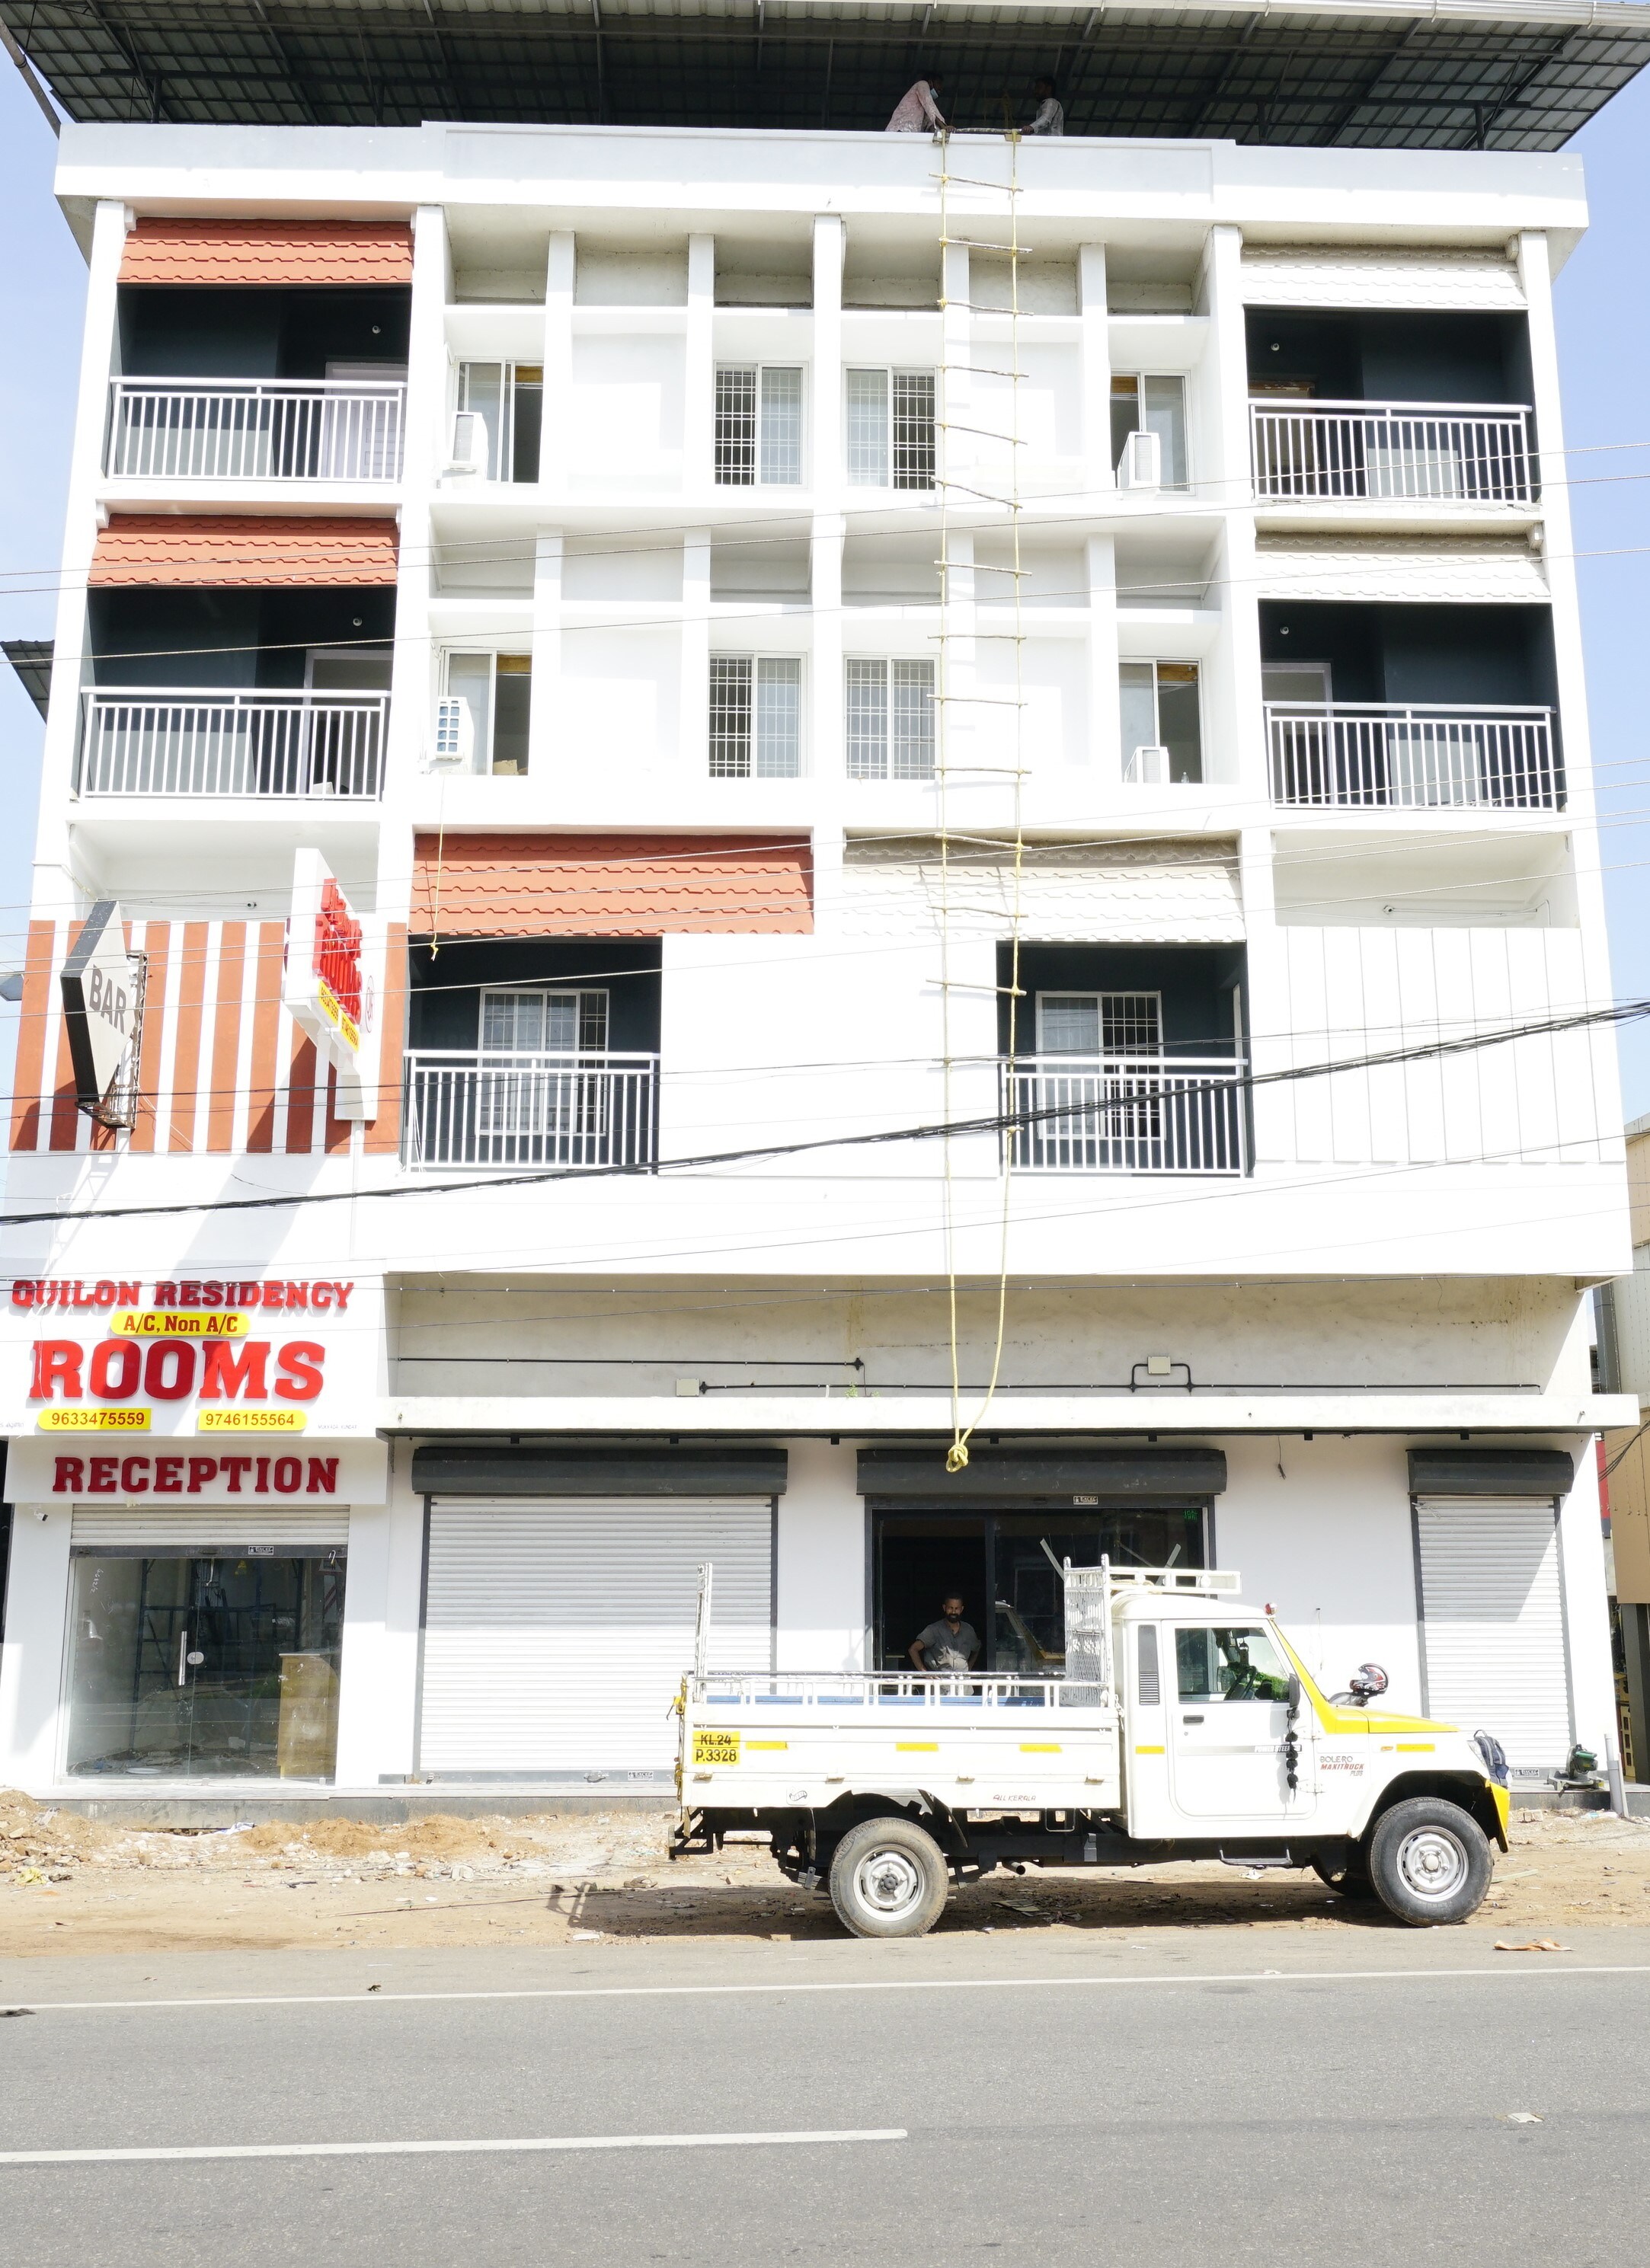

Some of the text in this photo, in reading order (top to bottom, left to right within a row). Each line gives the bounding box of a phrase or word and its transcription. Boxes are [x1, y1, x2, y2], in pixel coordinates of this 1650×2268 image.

[89, 964, 126, 1035] BAR
[12, 1279, 353, 1308] QUILON RESIDENCY
[123, 1314, 238, 1334] A/C, Non A/C
[29, 1339, 326, 1401] ROOMS
[51, 1412, 145, 1426] 9633475559
[206, 1413, 295, 1426] 9746155564
[52, 1456, 340, 1493] RECEPTION
[700, 1734, 731, 1746] KL.24
[695, 1749, 737, 1762] P.3328
